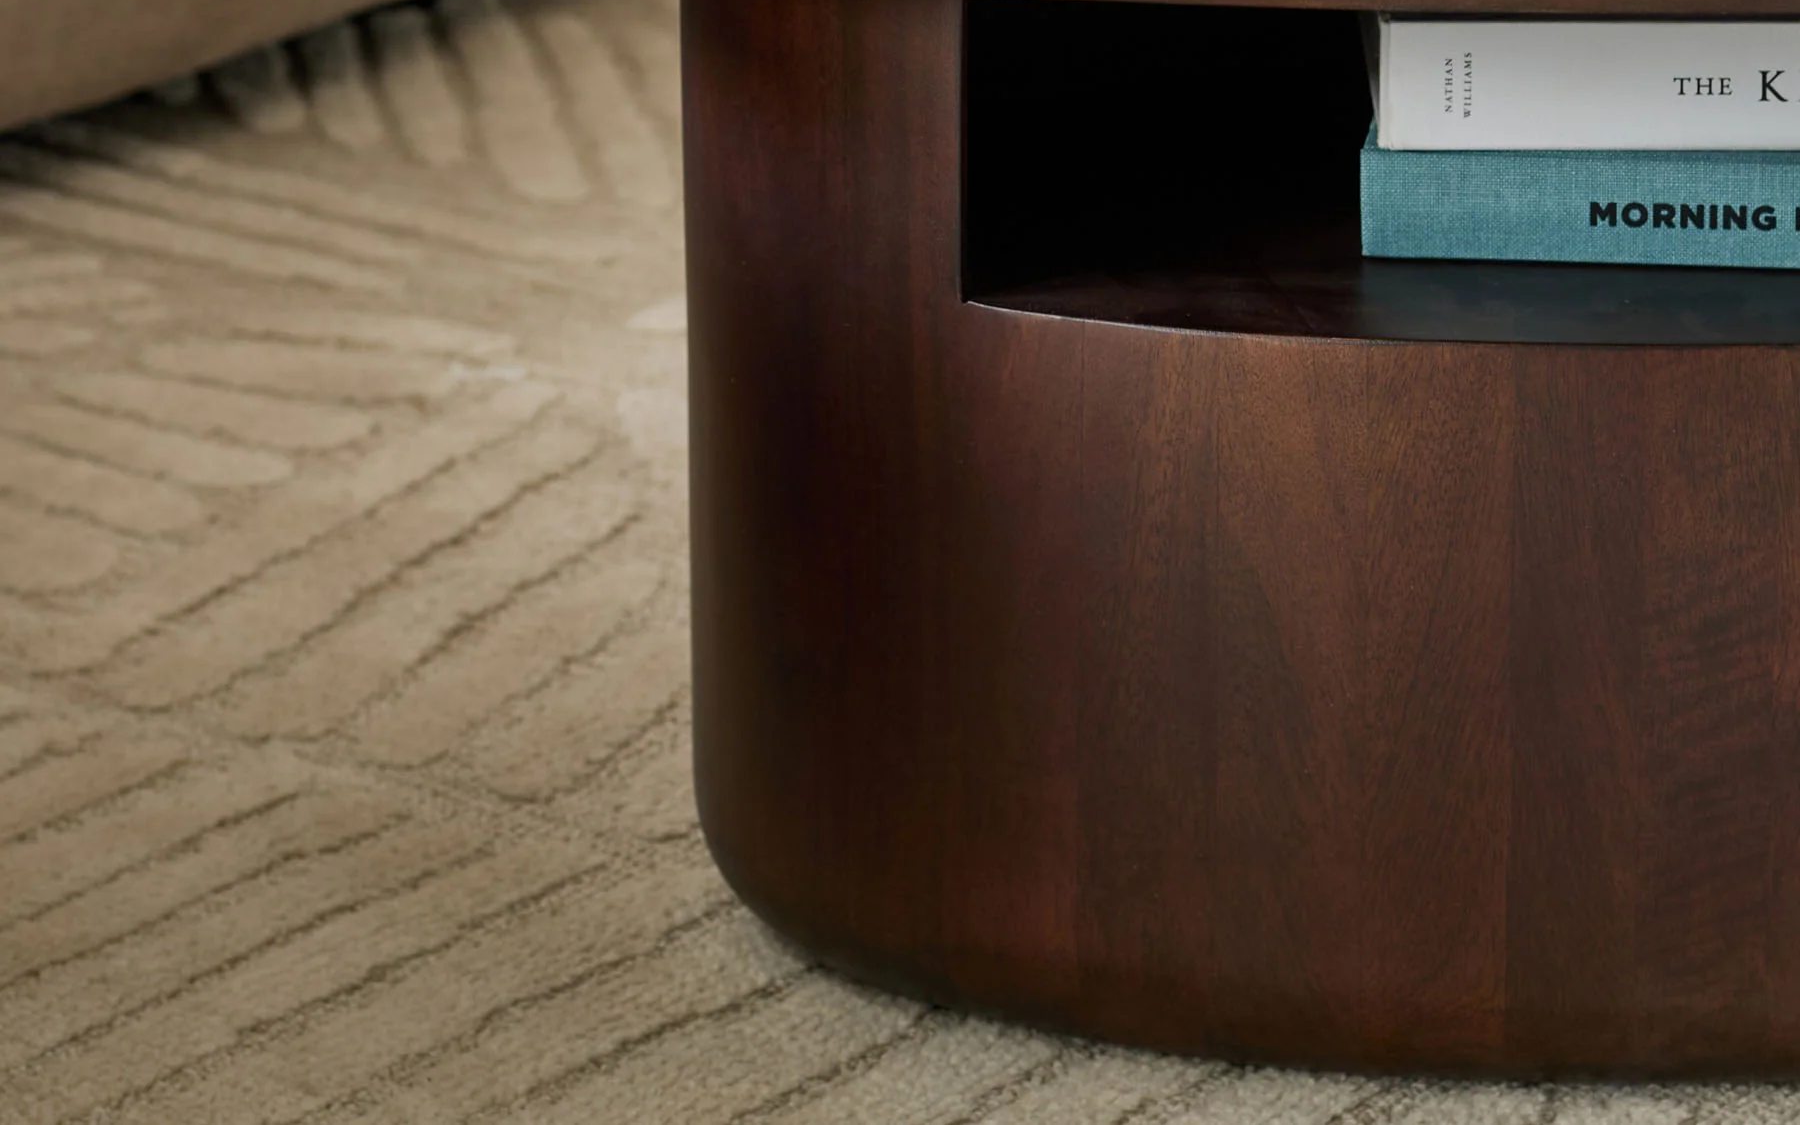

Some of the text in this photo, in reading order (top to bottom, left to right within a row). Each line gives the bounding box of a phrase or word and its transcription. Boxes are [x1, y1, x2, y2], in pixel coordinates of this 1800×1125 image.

[1444, 58, 1453, 113] NATHAN
[1463, 51, 1472, 119] WILLIAMS
[1673, 70, 1800, 103] THE K
[1589, 201, 1777, 232] MORNING
